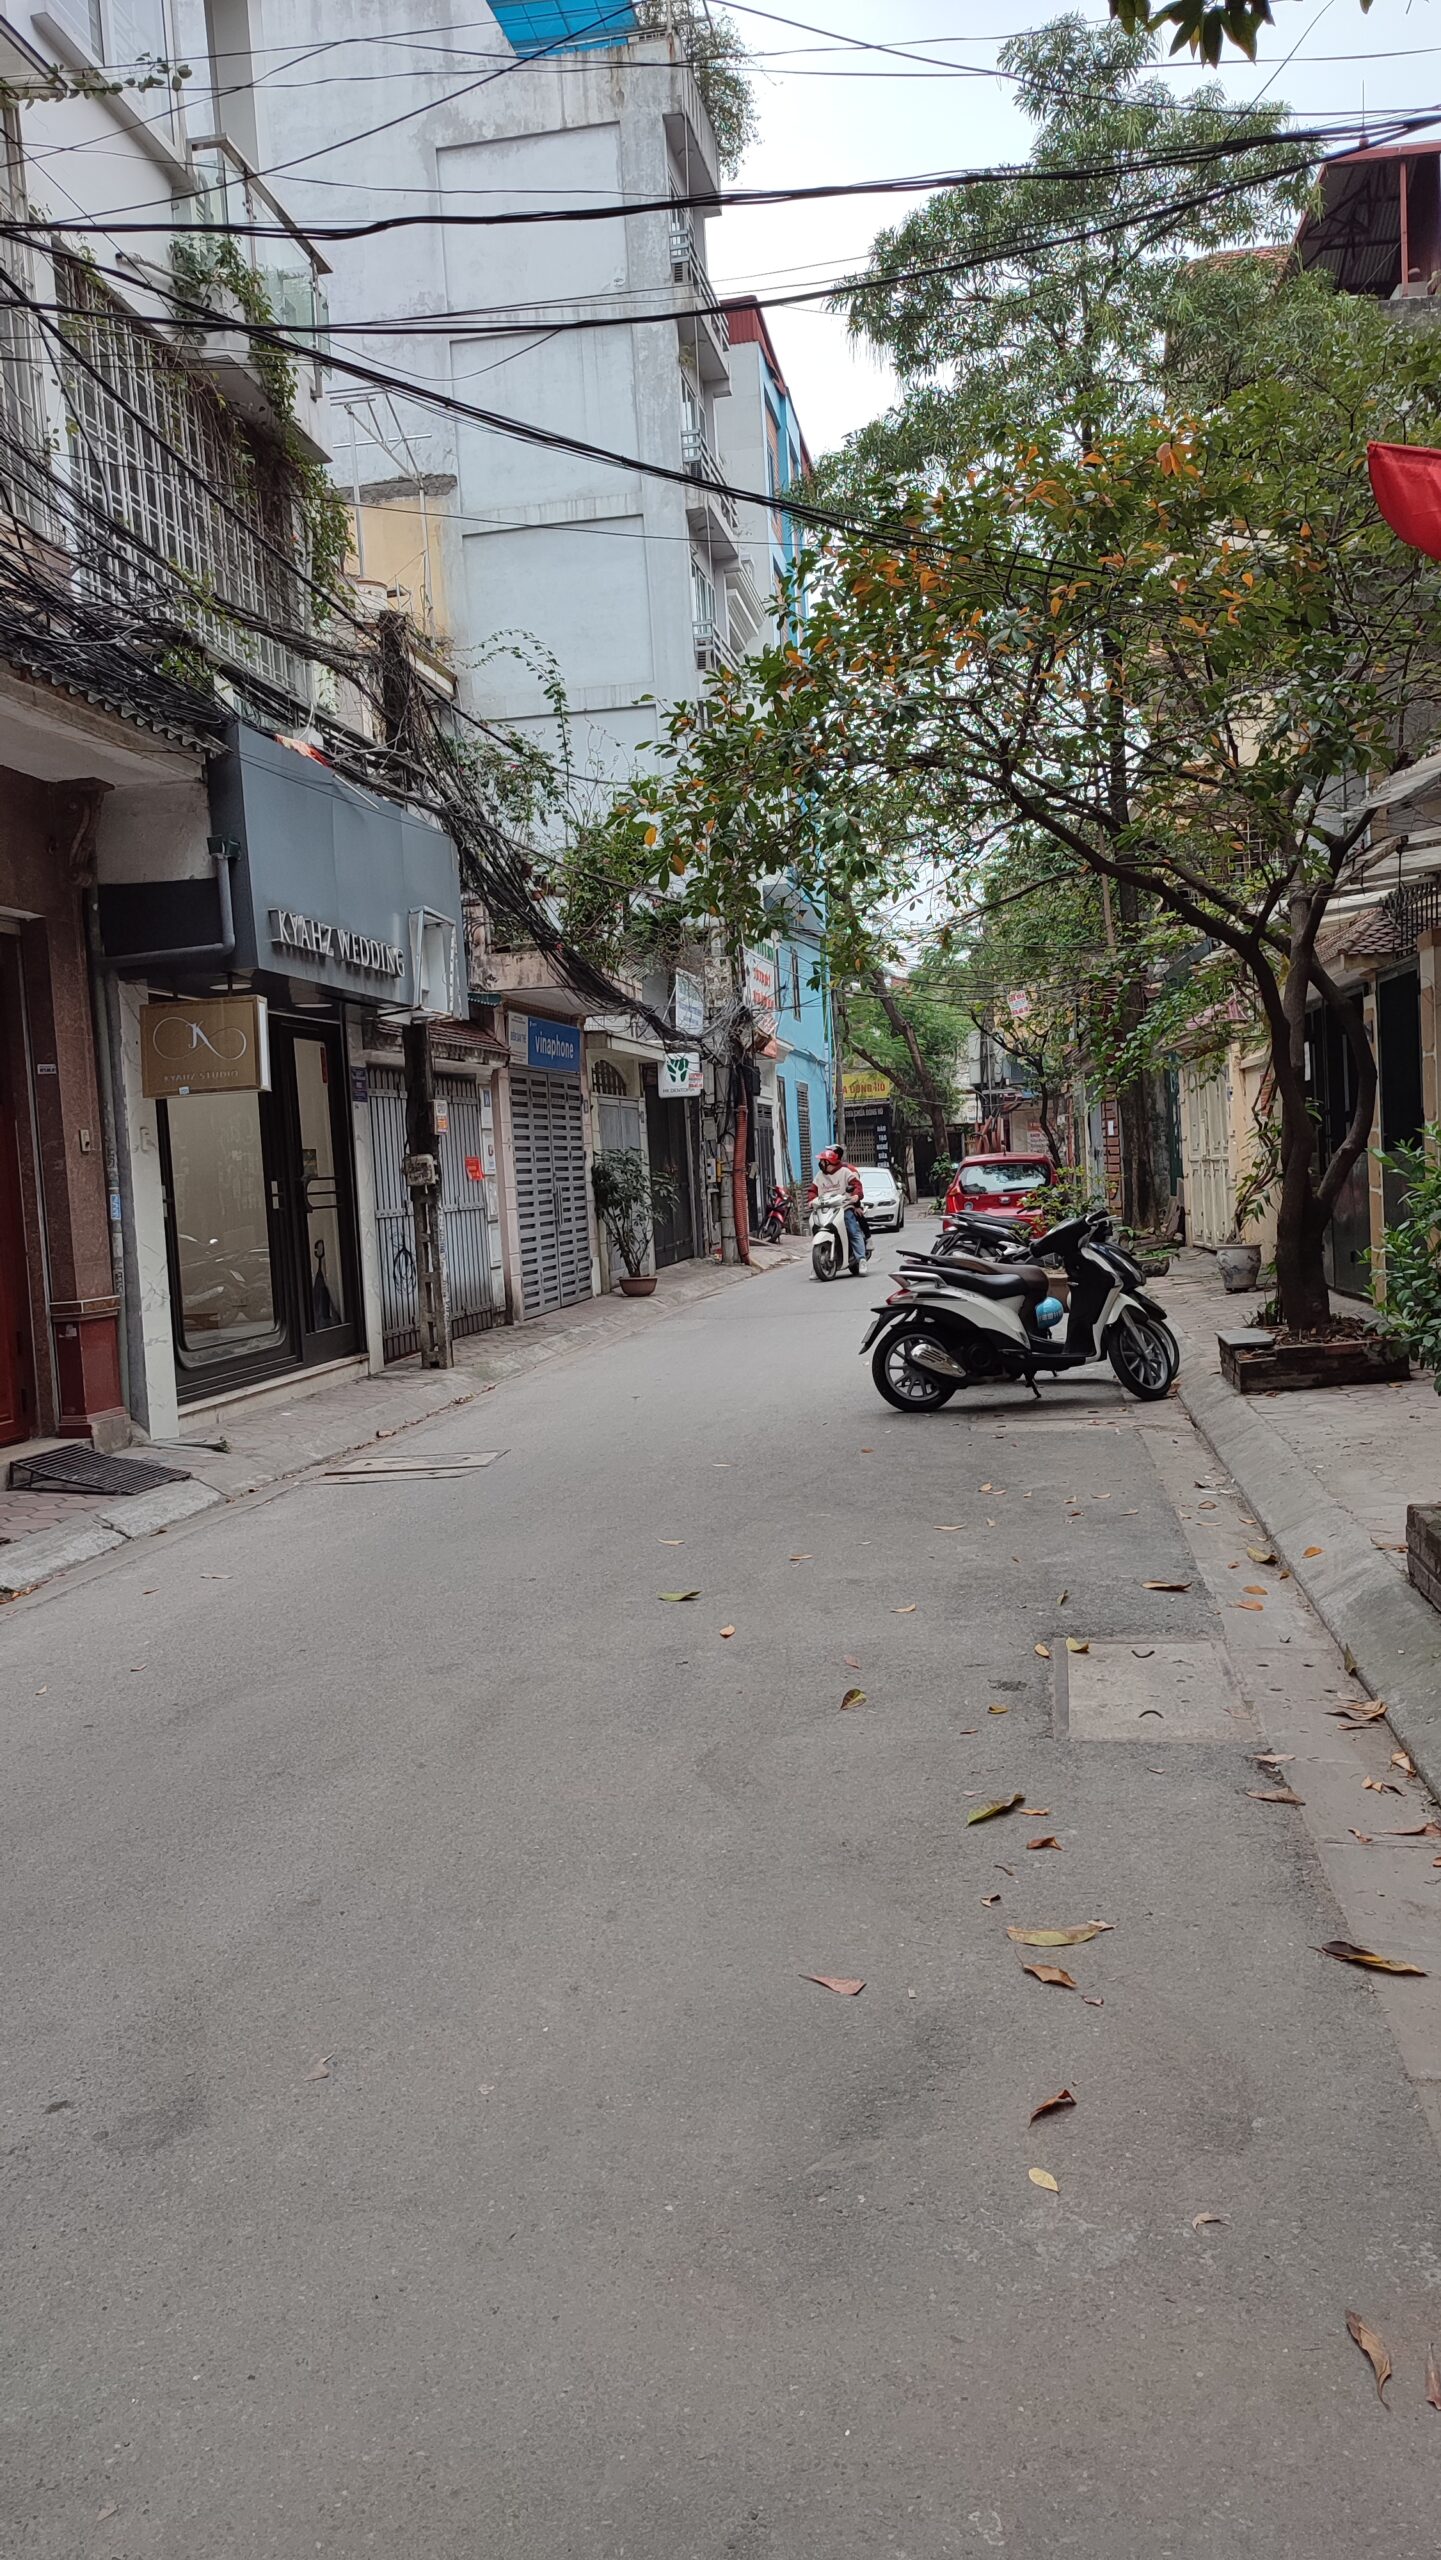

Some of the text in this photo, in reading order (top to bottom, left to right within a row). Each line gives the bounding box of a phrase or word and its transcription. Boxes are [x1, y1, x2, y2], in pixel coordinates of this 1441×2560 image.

[274, 908, 405, 977] KYAHZ WEDDING
[535, 1031, 574, 1059] vinaphone
